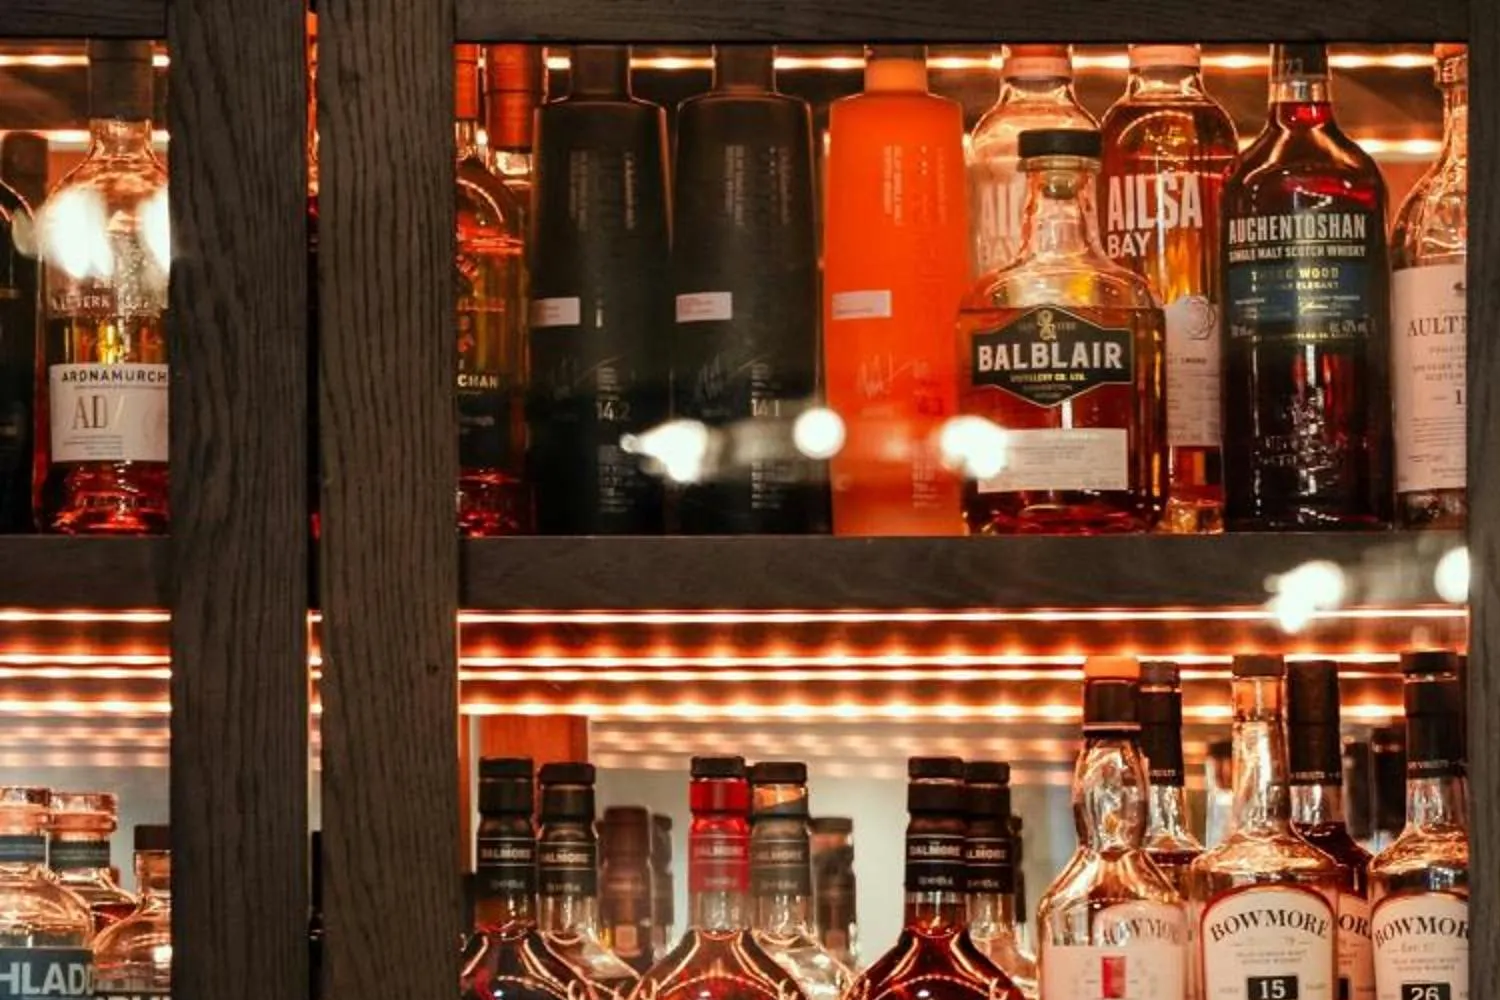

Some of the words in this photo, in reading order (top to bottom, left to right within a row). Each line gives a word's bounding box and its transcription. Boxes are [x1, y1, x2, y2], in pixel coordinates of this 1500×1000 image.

[1107, 172, 1203, 232] AILSA
[1228, 213, 1366, 244] AUCHENTOSHAN
[1107, 231, 1151, 259] BAY
[1299, 267, 1339, 279] WOOD
[977, 341, 1123, 372] BALBLAIR
[1210, 909, 1330, 942] BOWMORE
[1259, 979, 1286, 1000] 15
